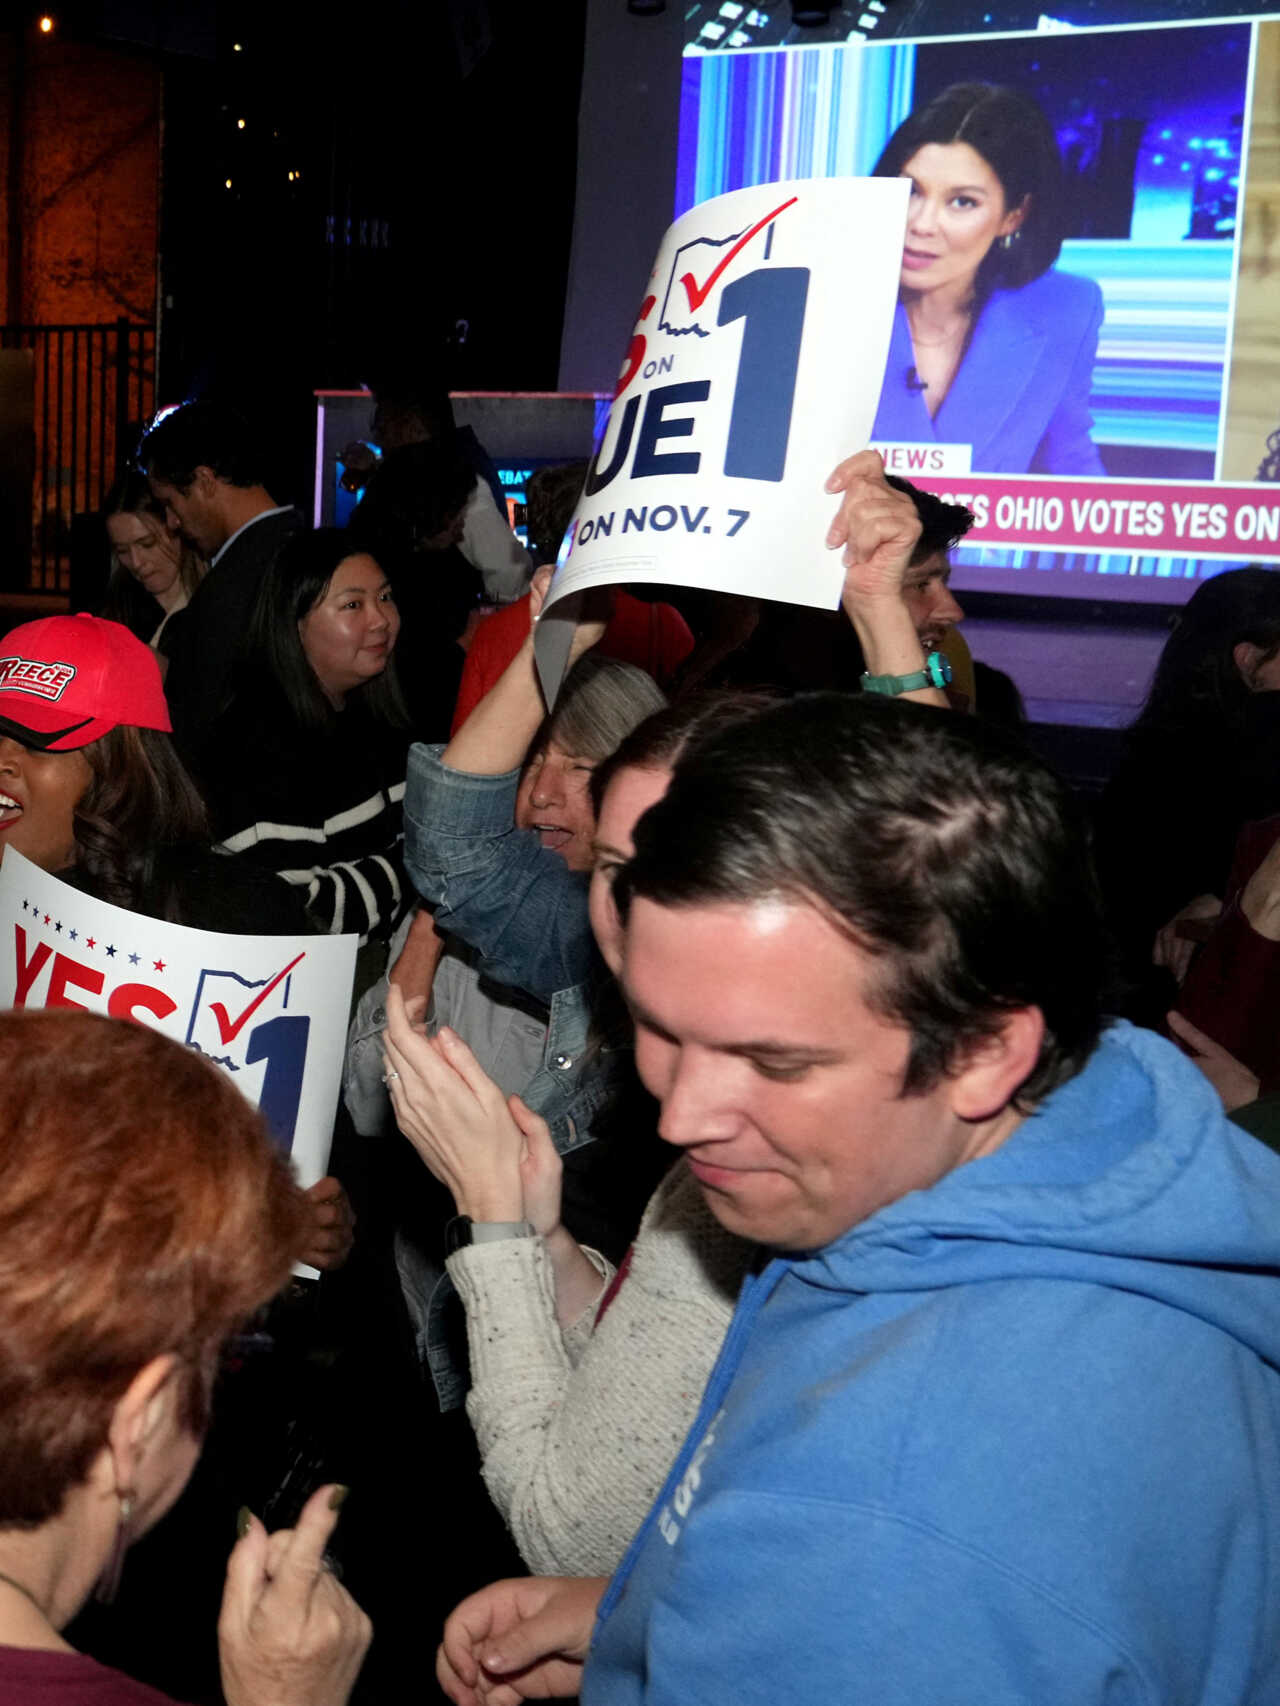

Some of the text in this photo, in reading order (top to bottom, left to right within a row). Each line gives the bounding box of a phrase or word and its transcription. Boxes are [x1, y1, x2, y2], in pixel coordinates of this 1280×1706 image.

[643, 354, 674, 379] ON
[717, 267, 810, 482] 1
[578, 511, 615, 546] ON
[622, 505, 712, 534] NOV.
[725, 509, 750, 538] 7
[995, 495, 1064, 531] OHIO
[1071, 498, 1165, 537] VOTES
[1172, 502, 1227, 539] YES
[1234, 504, 1279, 542] ON
[1, 658, 71, 687] REECE
[245, 1015, 310, 1160] 1
